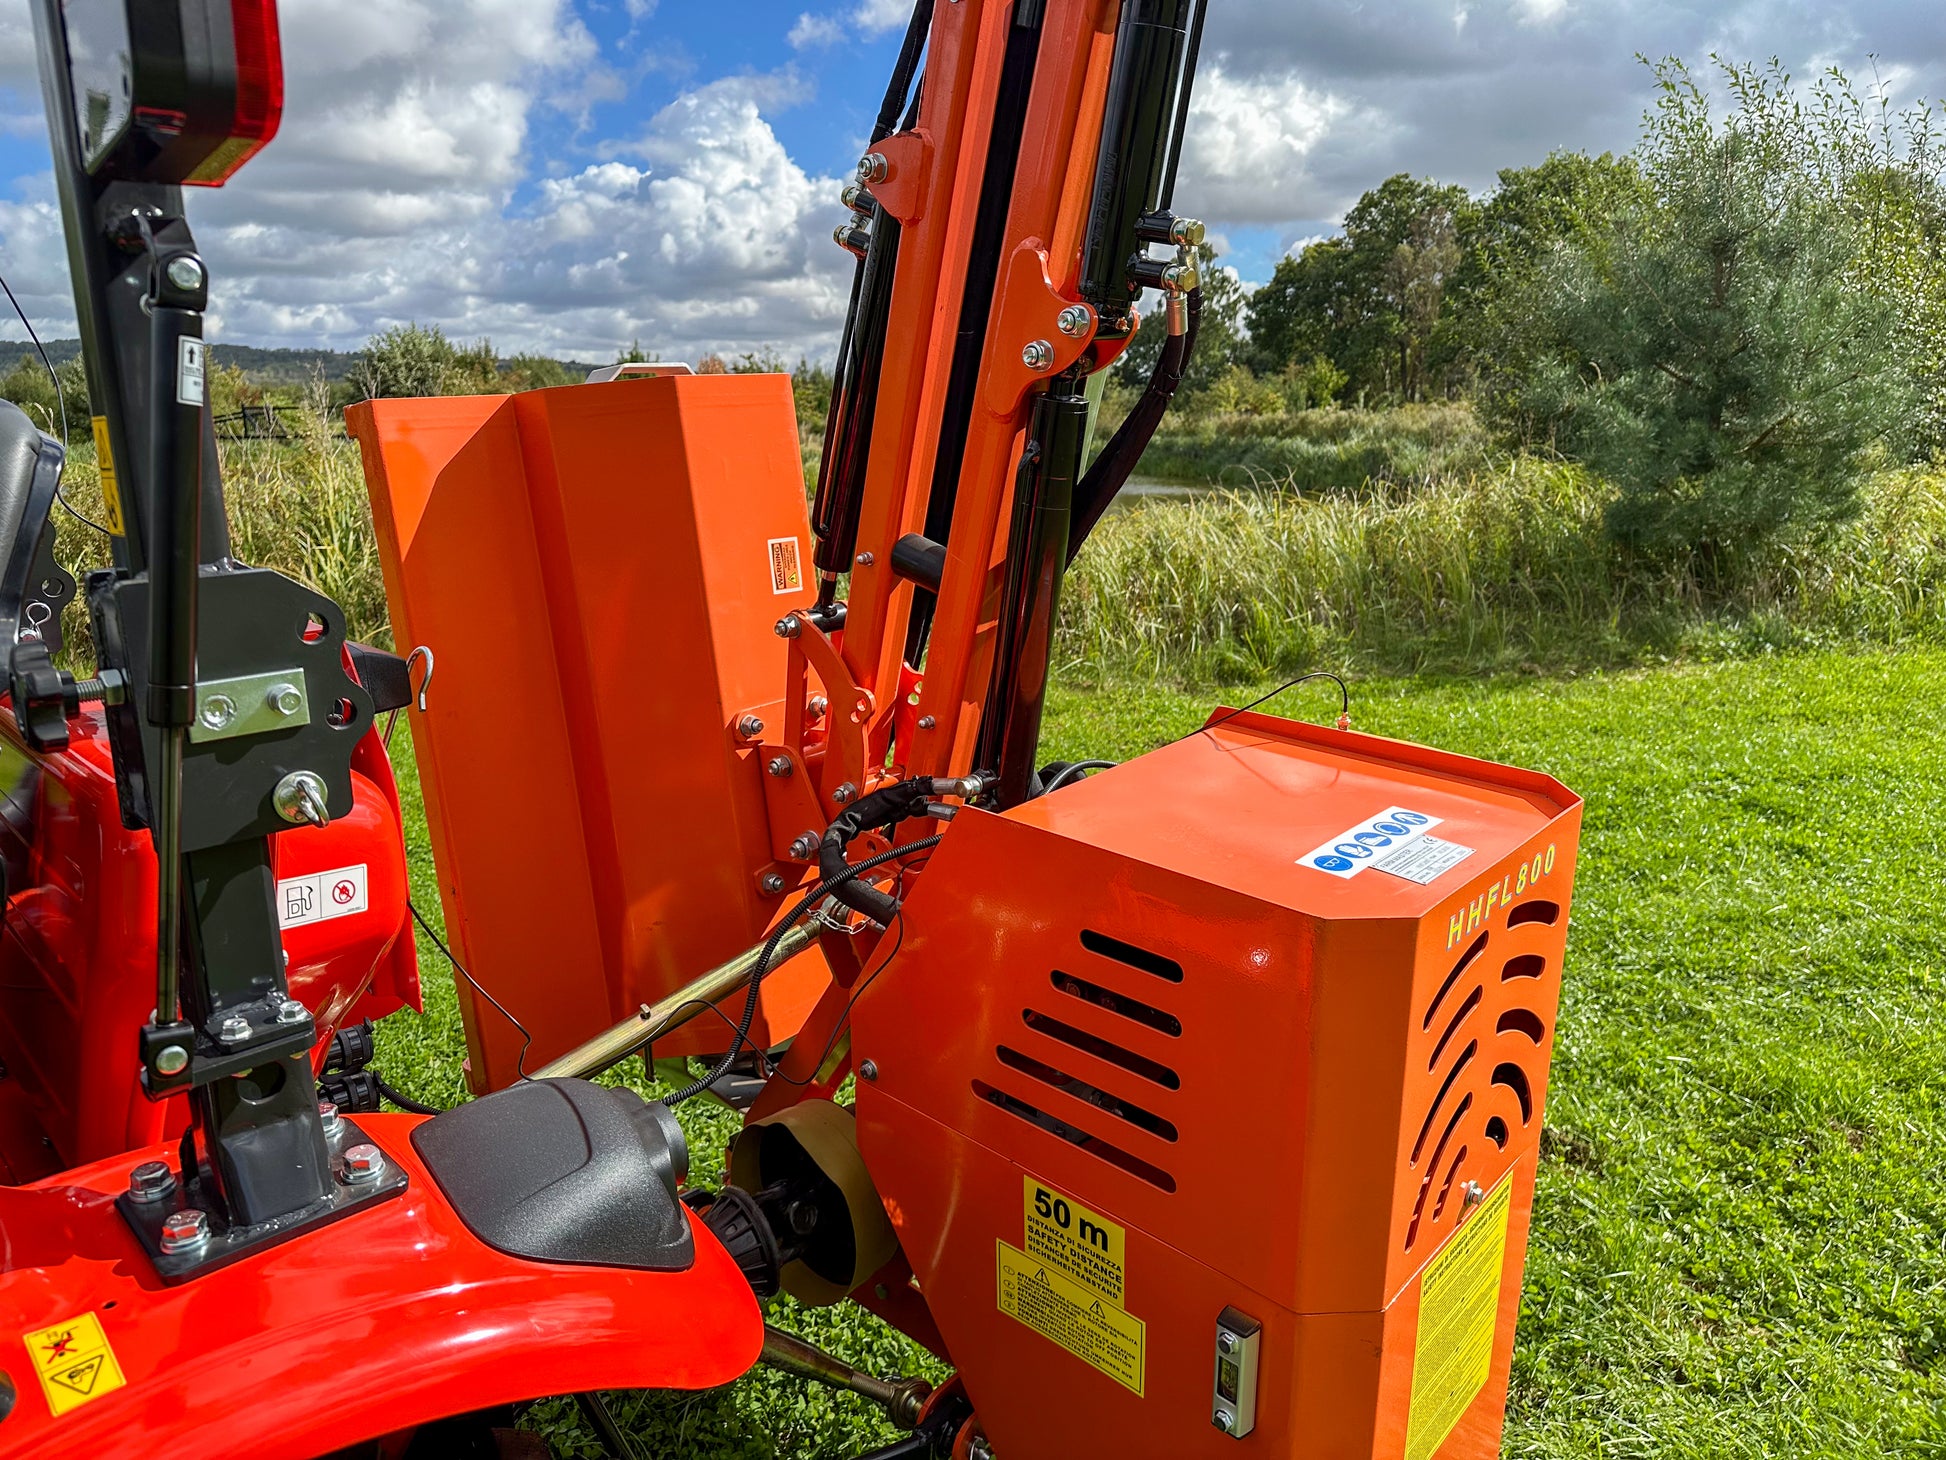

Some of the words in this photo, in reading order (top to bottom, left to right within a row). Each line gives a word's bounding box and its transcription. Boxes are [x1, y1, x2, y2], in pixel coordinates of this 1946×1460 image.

[775, 546, 783, 586] WARNING
[1447, 843, 1556, 951] HHFL800
[1027, 1215, 1065, 1240] DISTANZA
[1067, 1237, 1075, 1246] DI
[1076, 1242, 1122, 1273] SICUREZZA
[1034, 1187, 1071, 1229] 50
[1079, 1217, 1109, 1253] m
[1027, 1225, 1067, 1251] SAFETY
[1070, 1248, 1122, 1284] DISTANCE
[1027, 1235, 1070, 1262] DISTANCES
[1071, 1259, 1082, 1270] DE
[1083, 1263, 1122, 1293] SECURITE
[1028, 1244, 1118, 1300] SICHERHEITSABSTAND
